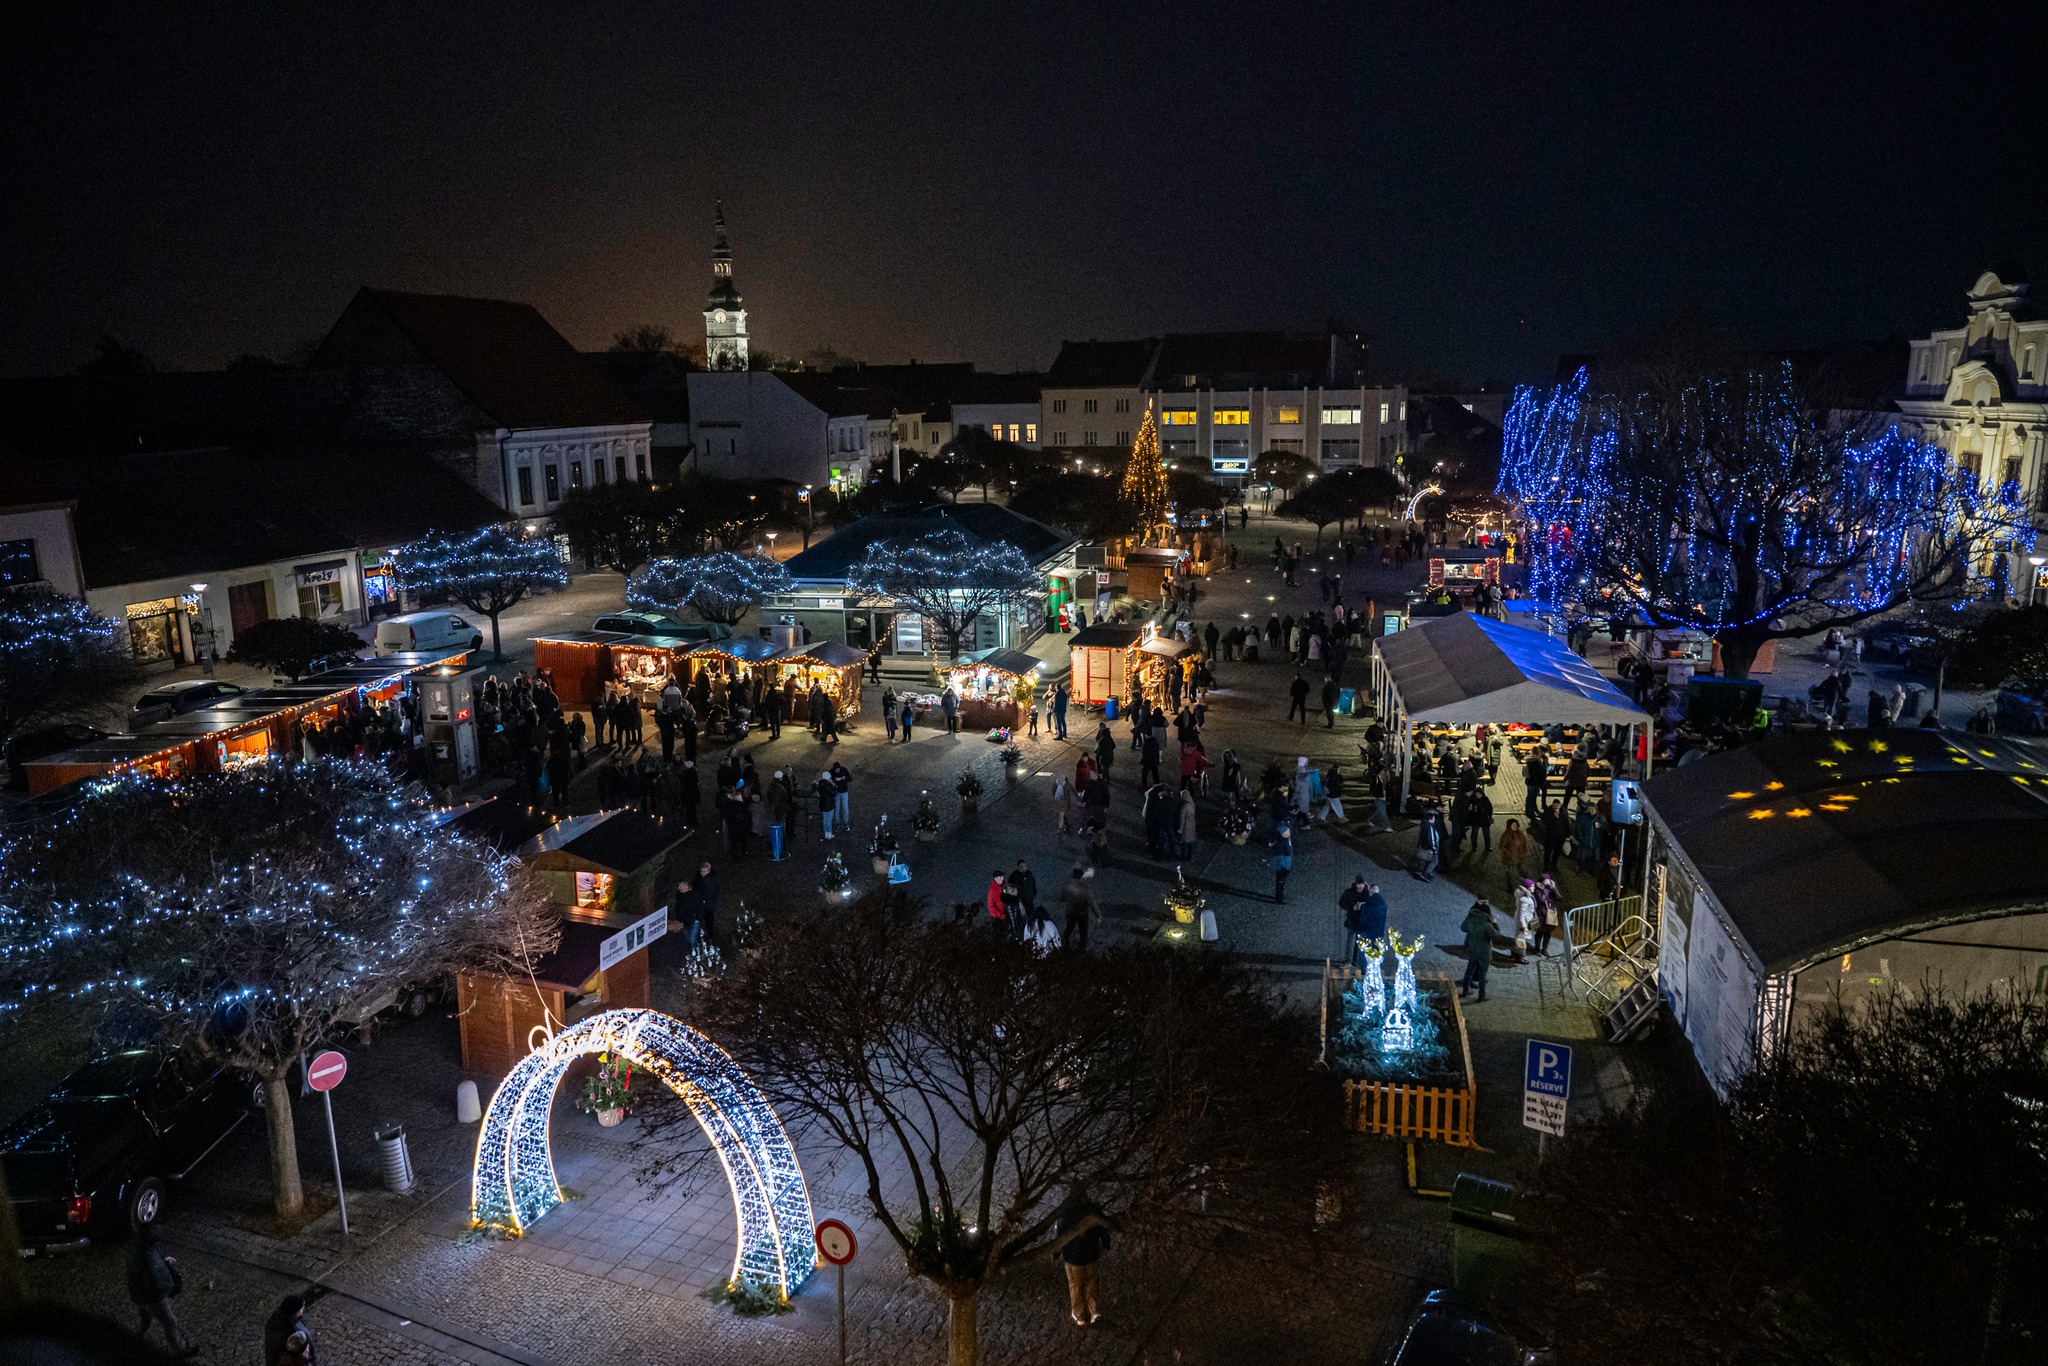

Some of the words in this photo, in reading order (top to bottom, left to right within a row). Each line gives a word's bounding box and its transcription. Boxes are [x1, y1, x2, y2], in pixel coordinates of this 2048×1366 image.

[1538, 1048, 1558, 1077] P
[1552, 1070, 1564, 1080] 3x
[1530, 1080, 1564, 1094] RÉSERVÉ
